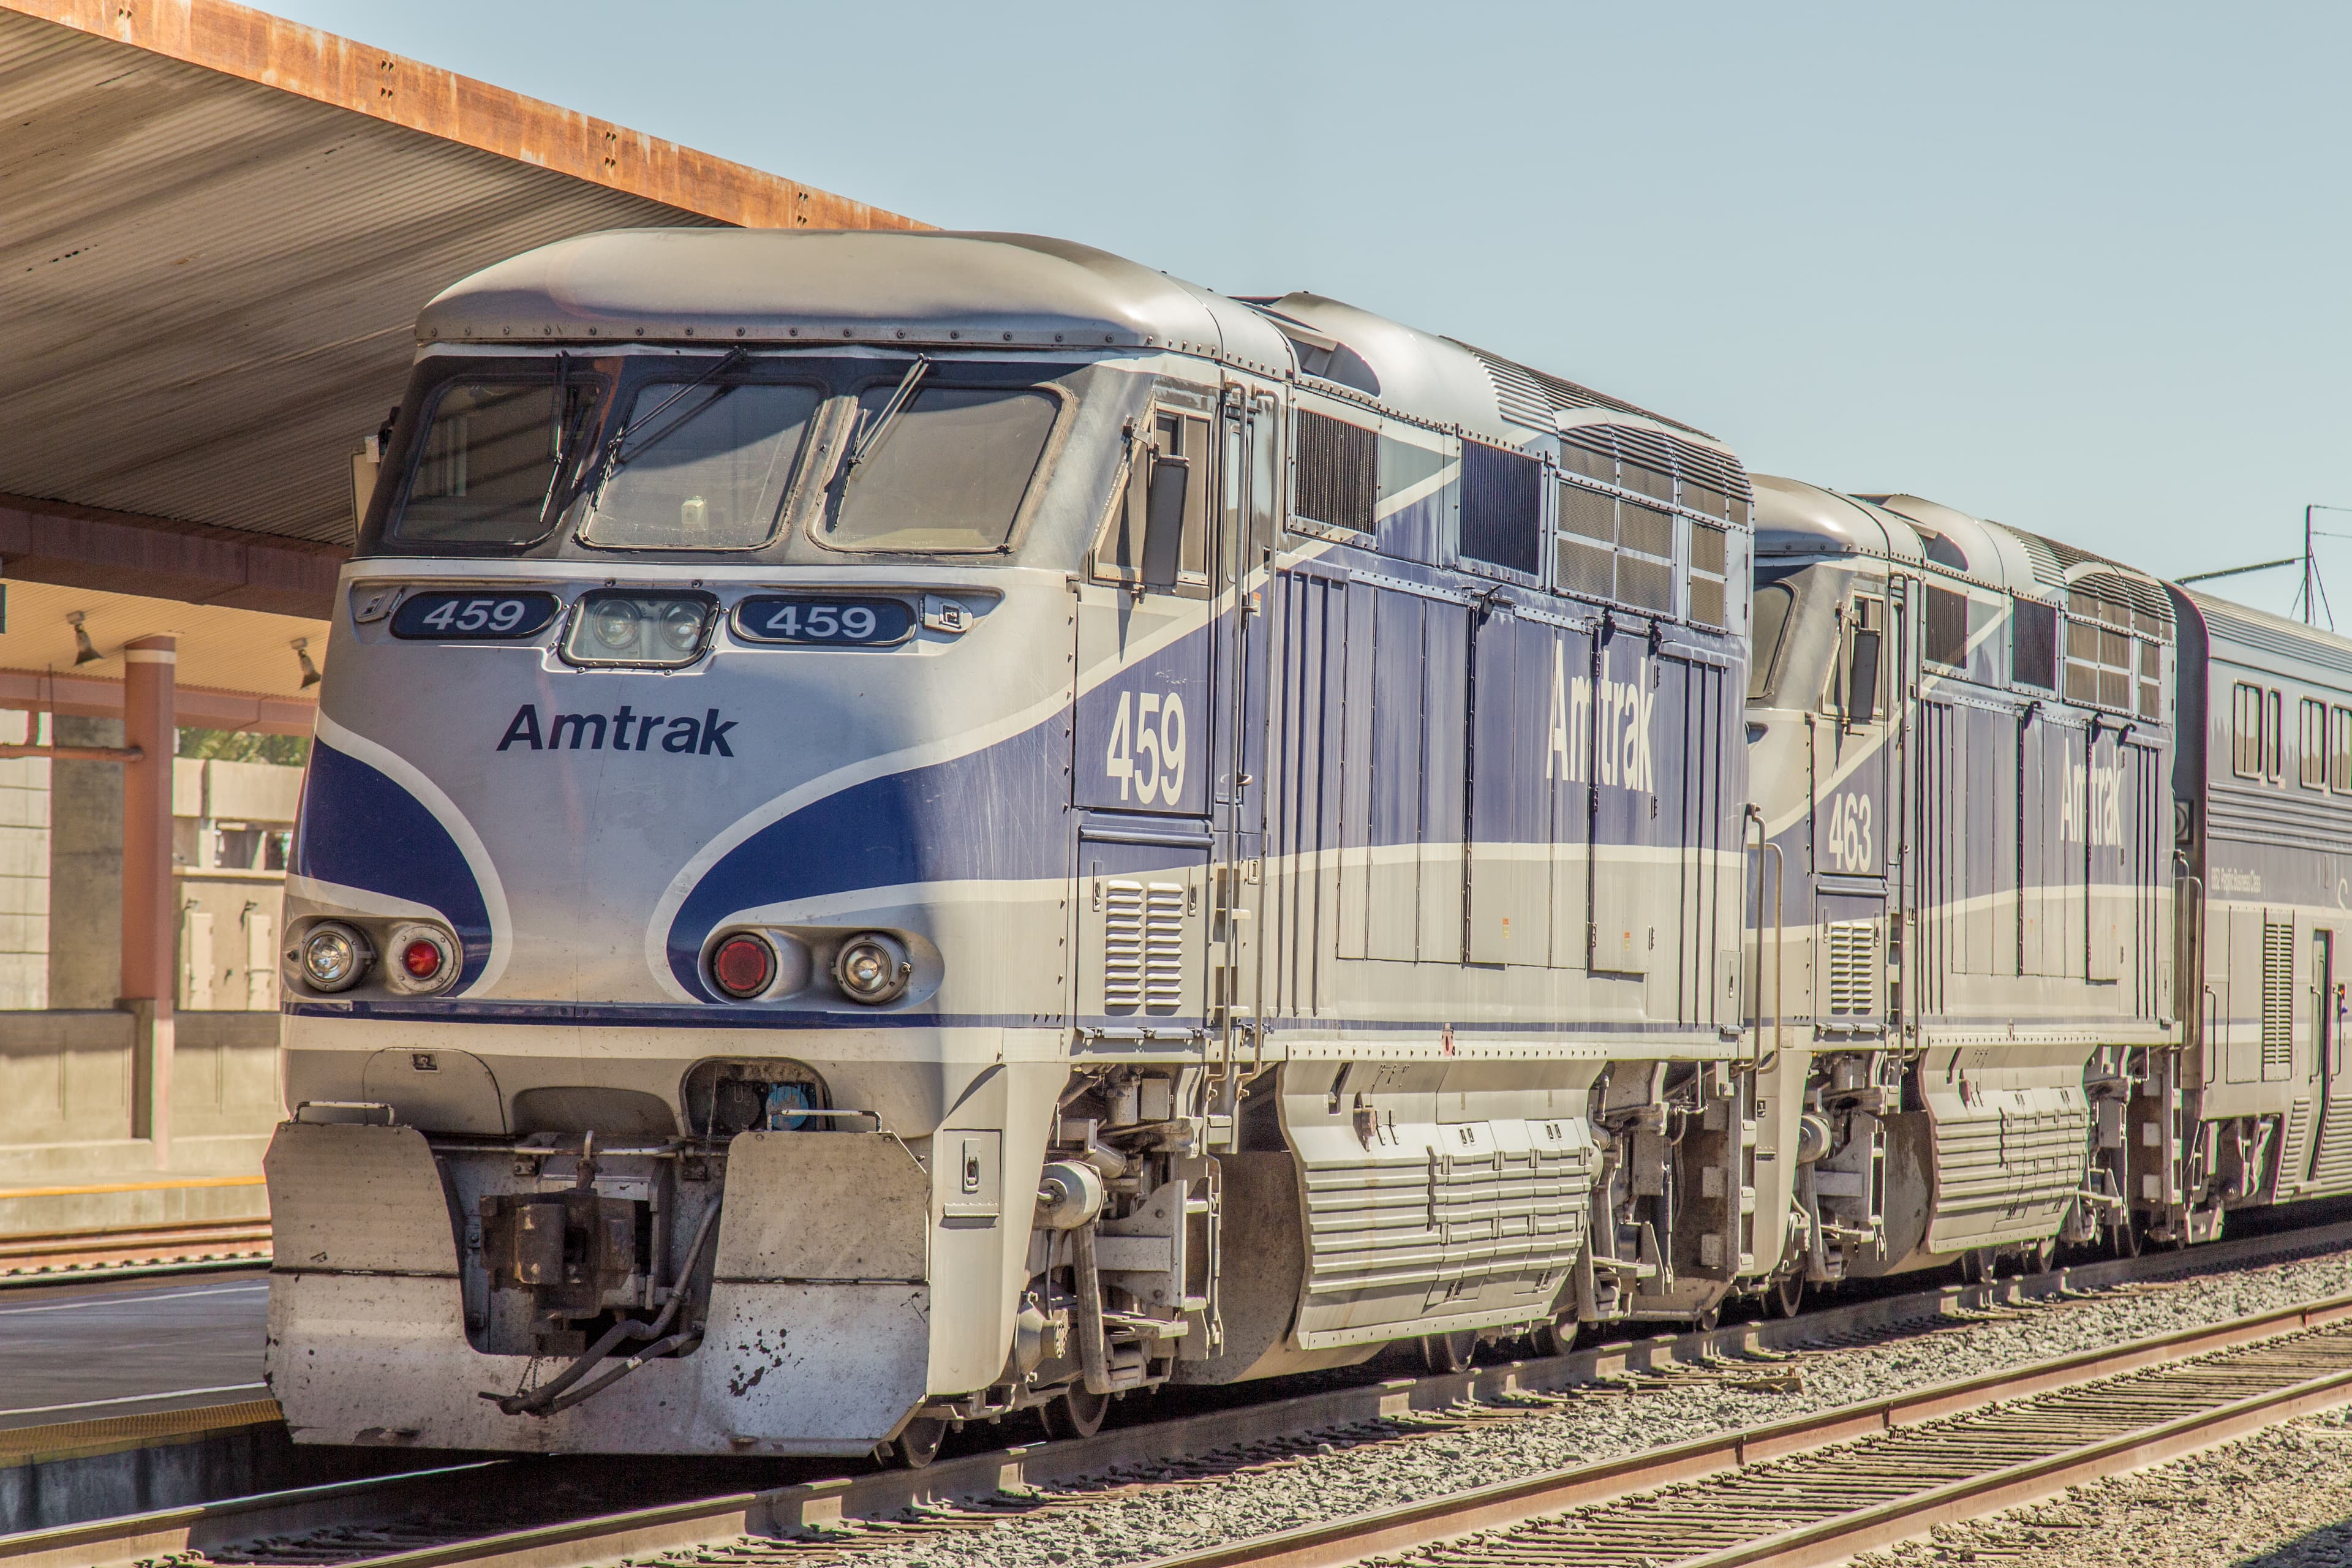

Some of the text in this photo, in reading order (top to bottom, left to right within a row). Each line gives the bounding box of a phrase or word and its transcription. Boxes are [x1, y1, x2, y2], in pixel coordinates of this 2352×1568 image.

[423, 600, 526, 631] 459
[766, 606, 876, 638] 459
[496, 703, 739, 757] Amtrak
[1107, 690, 1186, 806] 459
[1547, 639, 1654, 793] Amtrak
[2059, 737, 2122, 846] Amtrak
[1829, 792, 1872, 873] 463
[2251, 869, 2261, 894] Class
